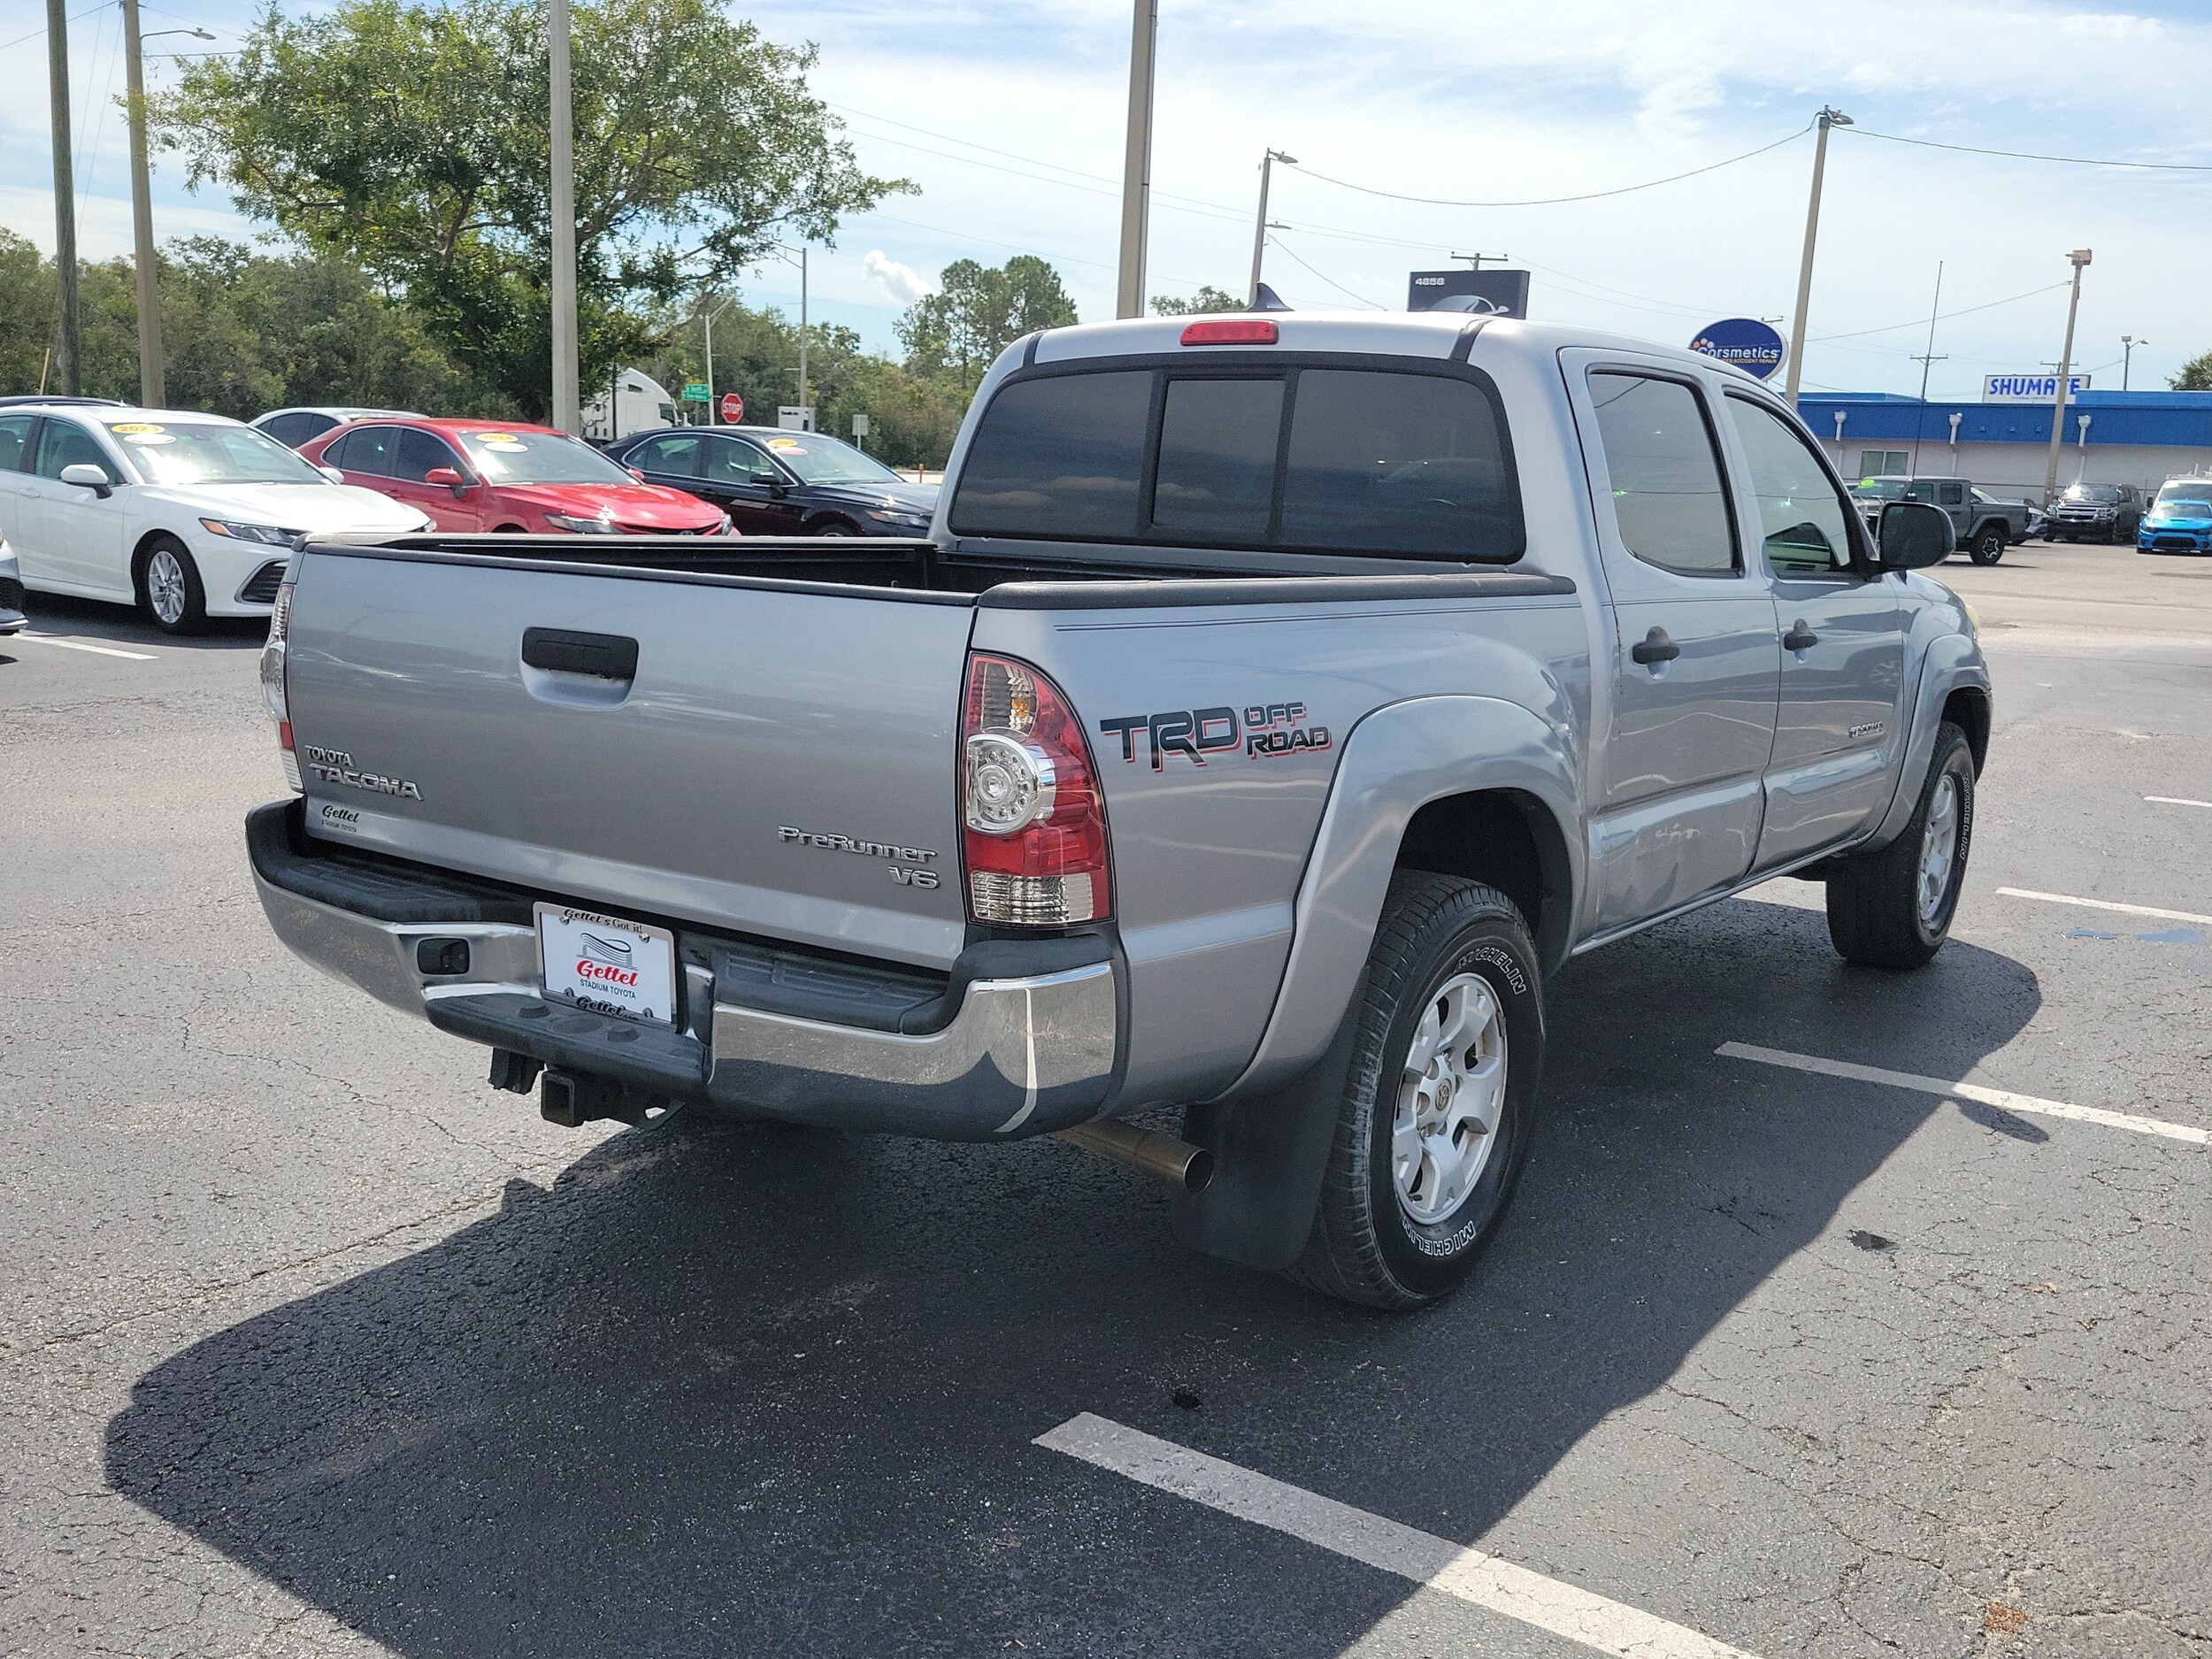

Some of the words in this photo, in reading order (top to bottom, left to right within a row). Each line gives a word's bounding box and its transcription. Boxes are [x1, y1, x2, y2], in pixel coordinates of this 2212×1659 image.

[1988, 378, 2081, 396] SHUMAE
[724, 403, 742, 414] STOP
[1100, 706, 1241, 773] TRD
[1243, 702, 1307, 732] OFF
[1246, 726, 1333, 759] ROAD
[304, 744, 356, 768] TOYOTA
[310, 763, 425, 802] TACOMA
[322, 805, 360, 824] Gettel
[341, 822, 357, 833] TOYOTA
[778, 825, 939, 864] PreRunner
[887, 865, 941, 890] V6
[612, 918, 630, 930] Got
[576, 960, 639, 987] Gettel
[580, 979, 609, 993] STADIUM
[610, 986, 637, 999] TOYOTA
[1402, 1215, 1477, 1256] MICHELIN
